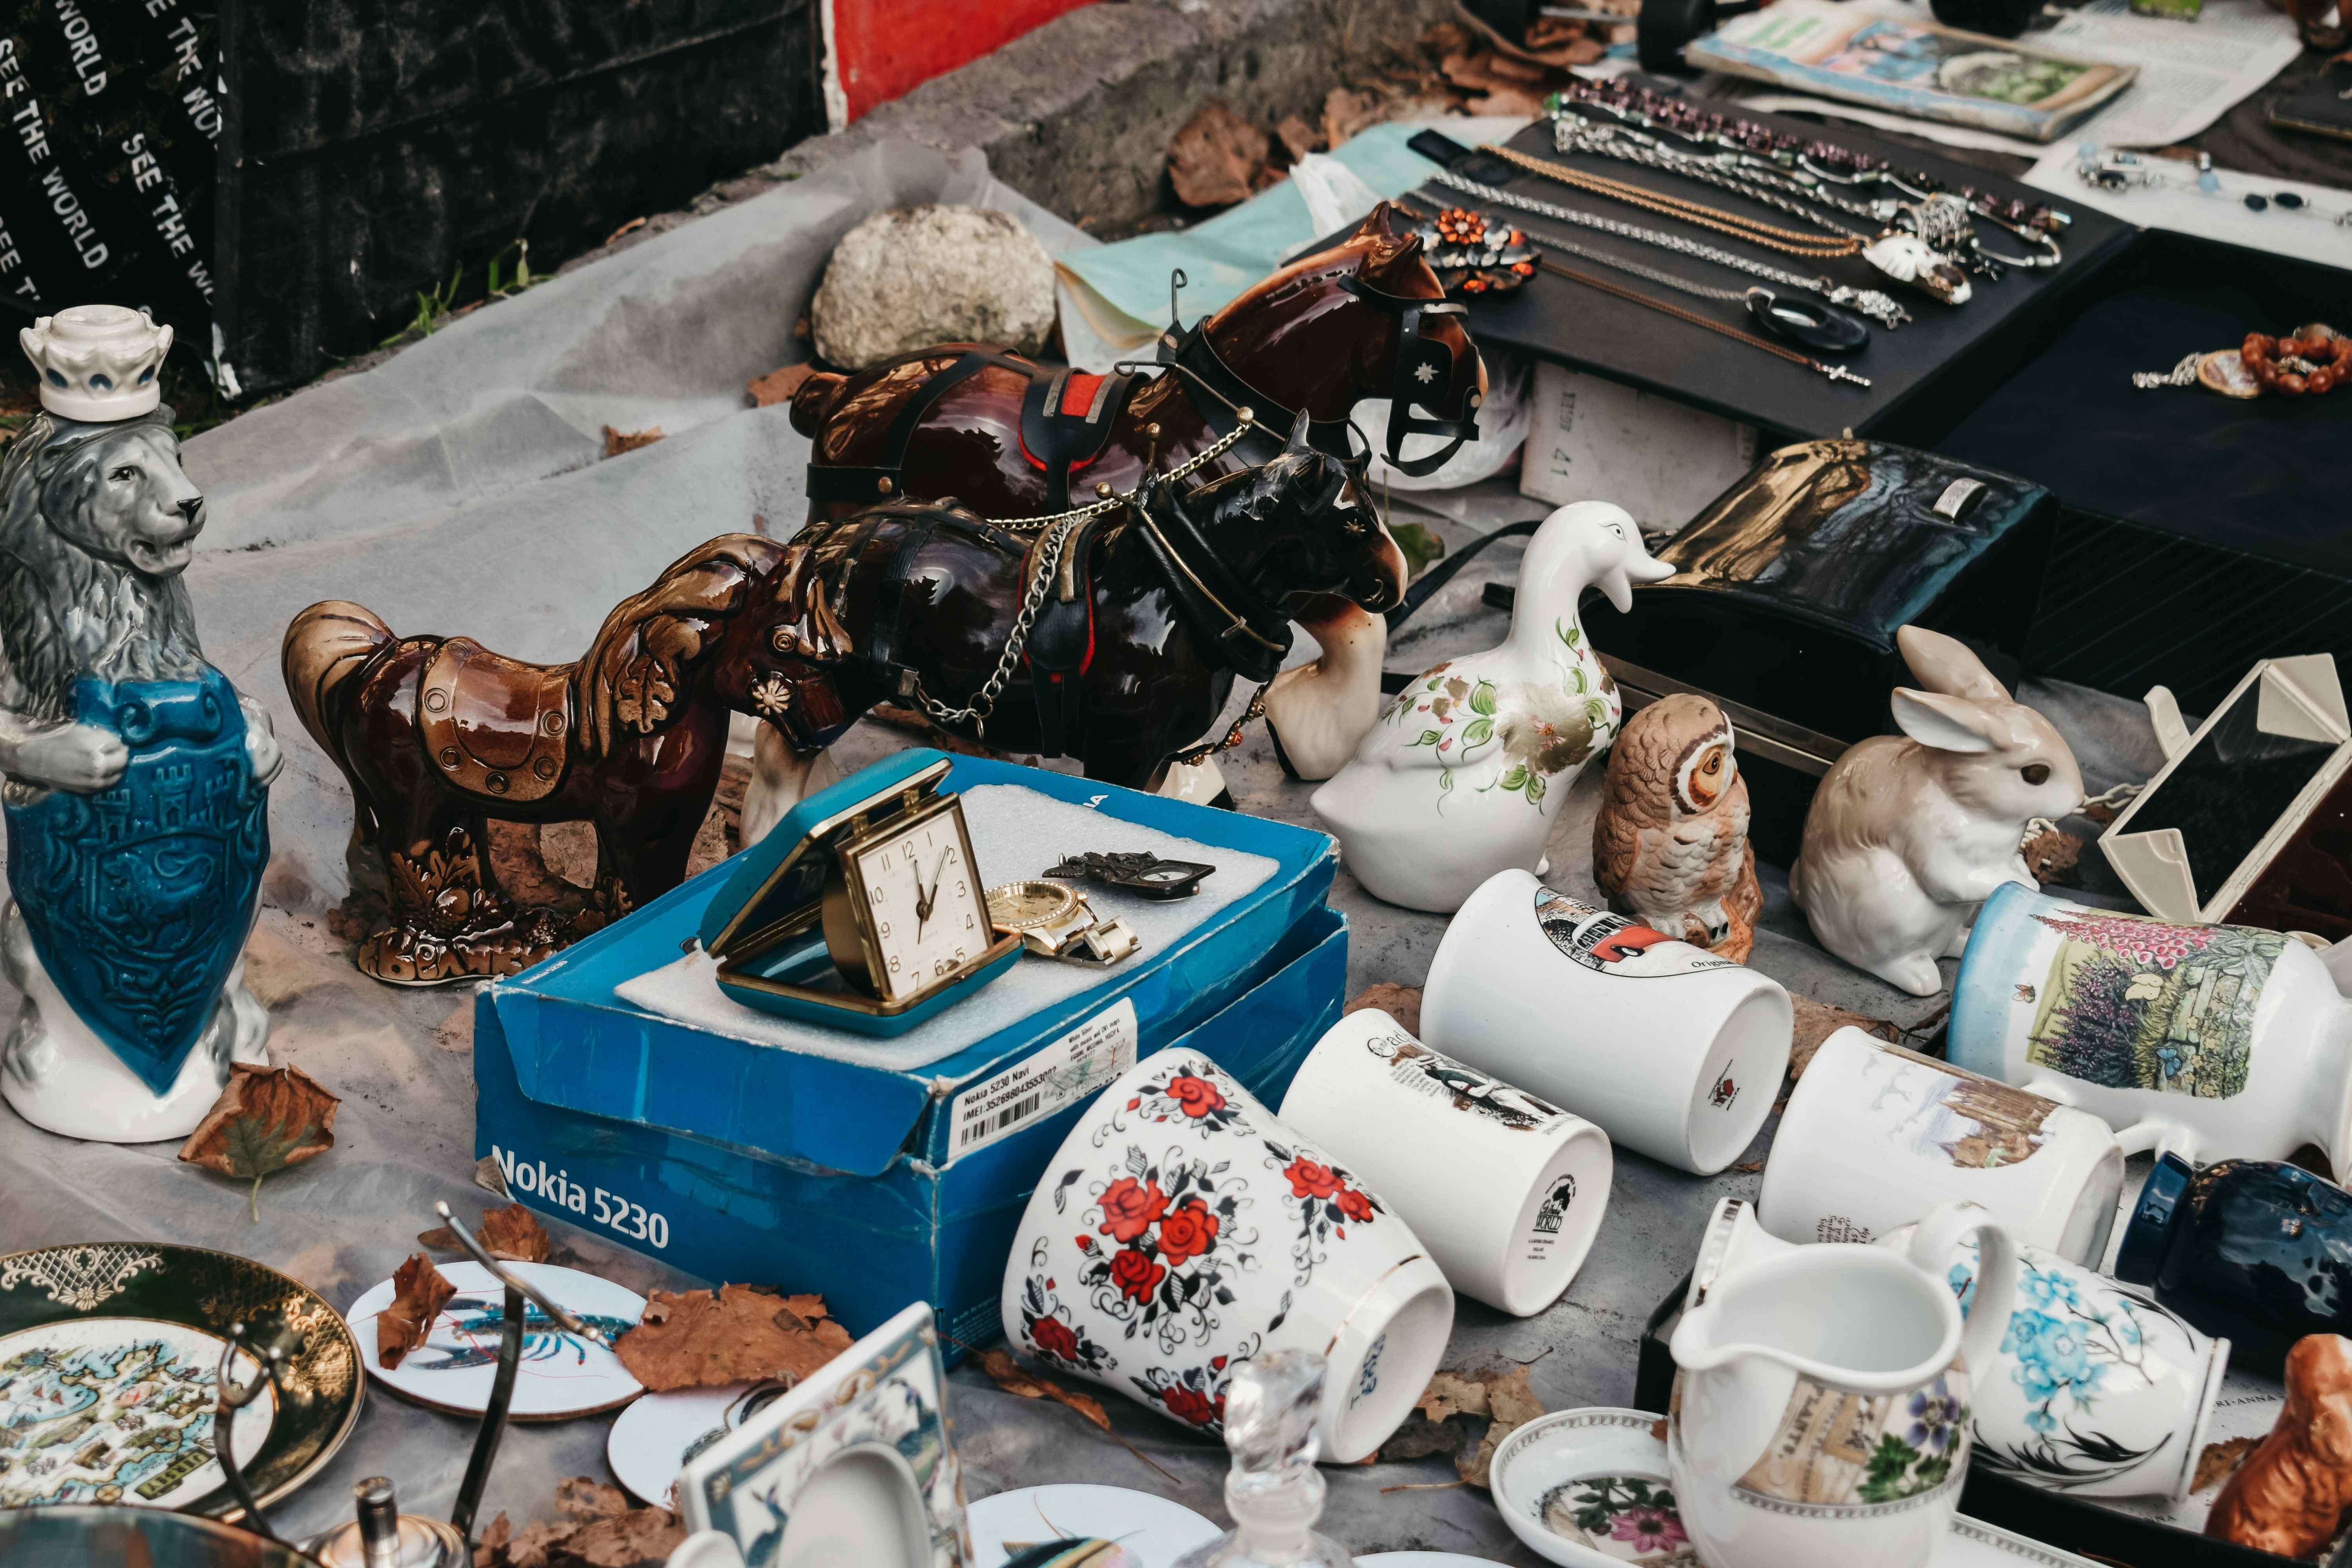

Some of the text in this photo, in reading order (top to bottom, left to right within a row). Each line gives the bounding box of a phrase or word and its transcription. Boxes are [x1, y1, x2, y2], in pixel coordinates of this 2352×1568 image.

[13, 99, 51, 164] THE
[42, 167, 109, 269] WORLD
[122, 132, 163, 193] SEE
[152, 194, 194, 259] THE
[0, 215, 22, 273] EE
[927, 832, 933, 847] 1
[902, 841, 916, 861] 12
[948, 848, 958, 865] 2
[881, 854, 891, 872] 11
[869, 886, 884, 906] 10
[955, 880, 966, 898] 3
[881, 922, 891, 938] 9
[966, 914, 974, 930] 4
[890, 955, 900, 973] 8
[956, 947, 965, 964] 5
[935, 959, 944, 976] 6
[911, 971, 920, 991] 7
[965, 1065, 1029, 1106] Nokia 5230 Navi
[492, 1144, 669, 1249] Nokia 5230
[1535, 1215, 1563, 1230] WORLD
[144, 1451, 207, 1492] JERSEY
